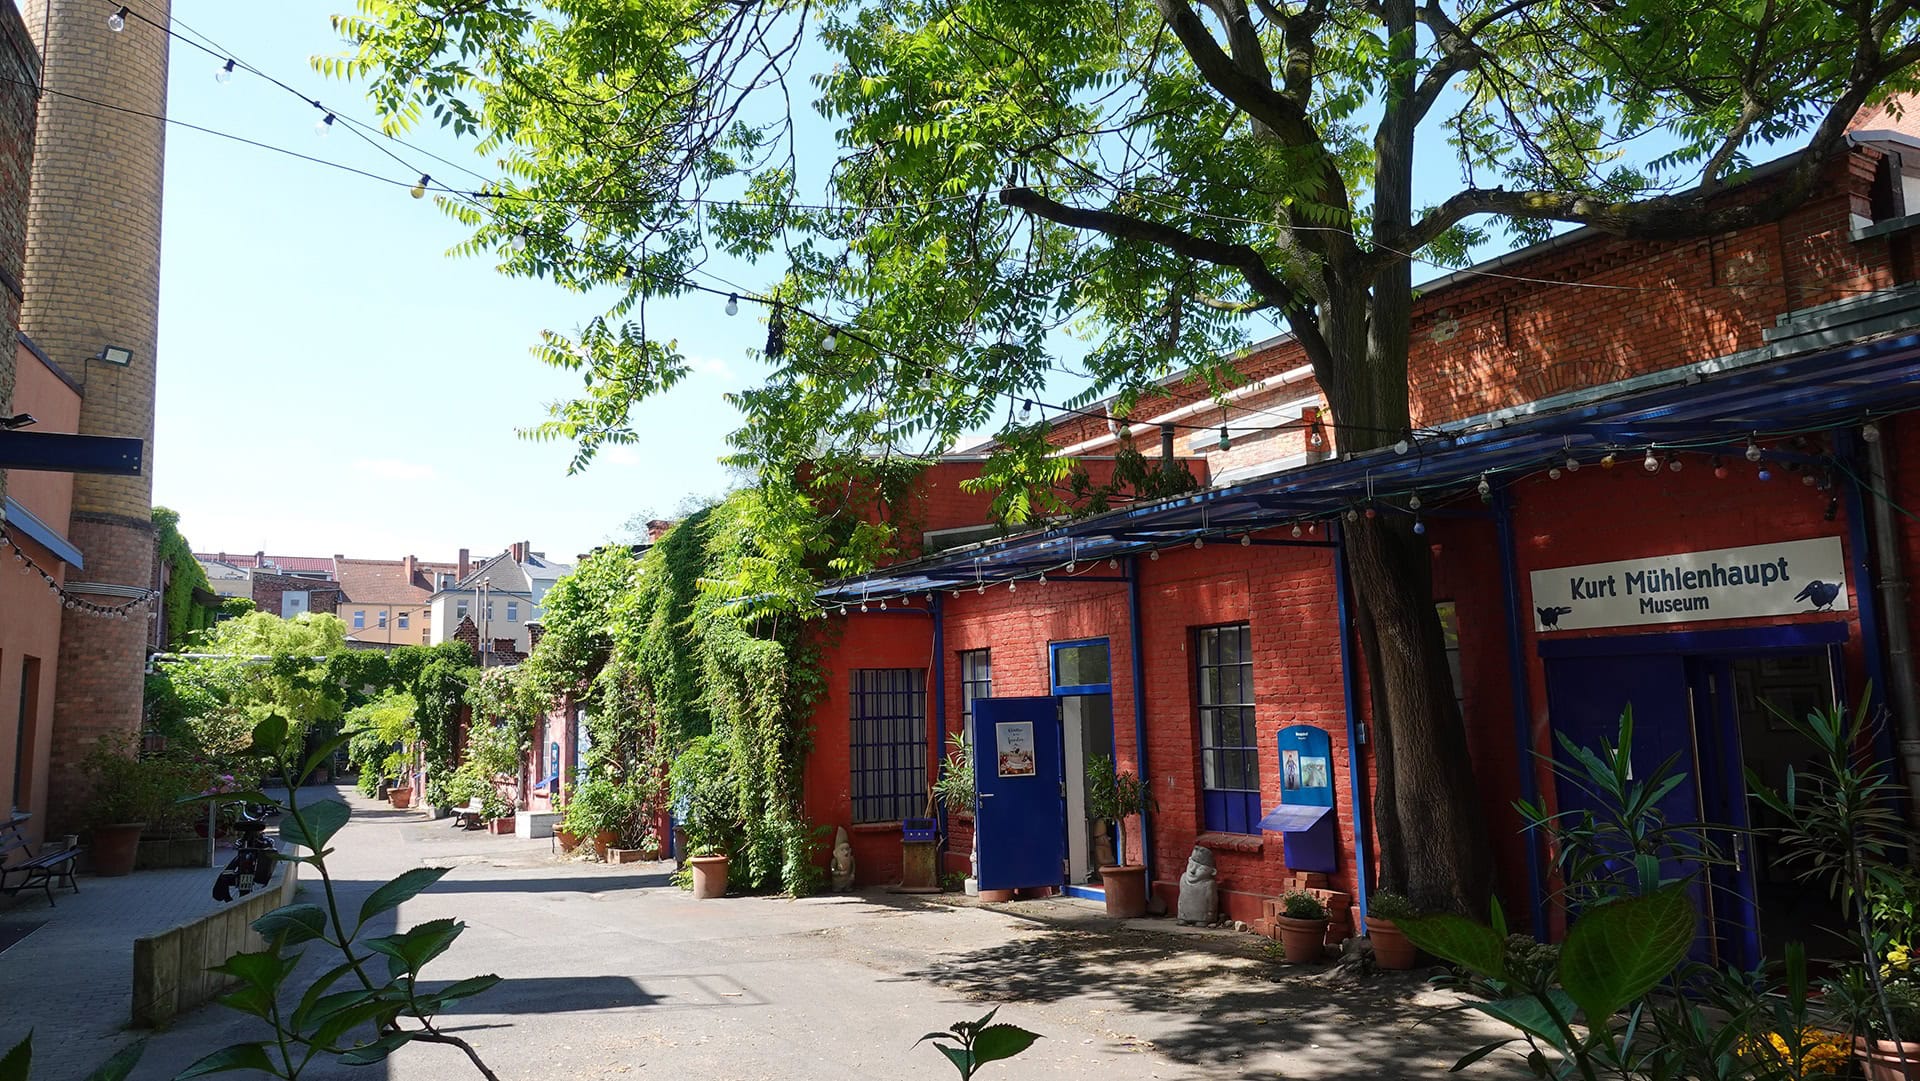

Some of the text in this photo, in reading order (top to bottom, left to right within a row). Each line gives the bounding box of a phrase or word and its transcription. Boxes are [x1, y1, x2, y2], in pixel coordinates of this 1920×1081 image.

[1570, 557, 1790, 600] Kurt Mühlenhaupt
[1640, 596, 1709, 614] Museum
